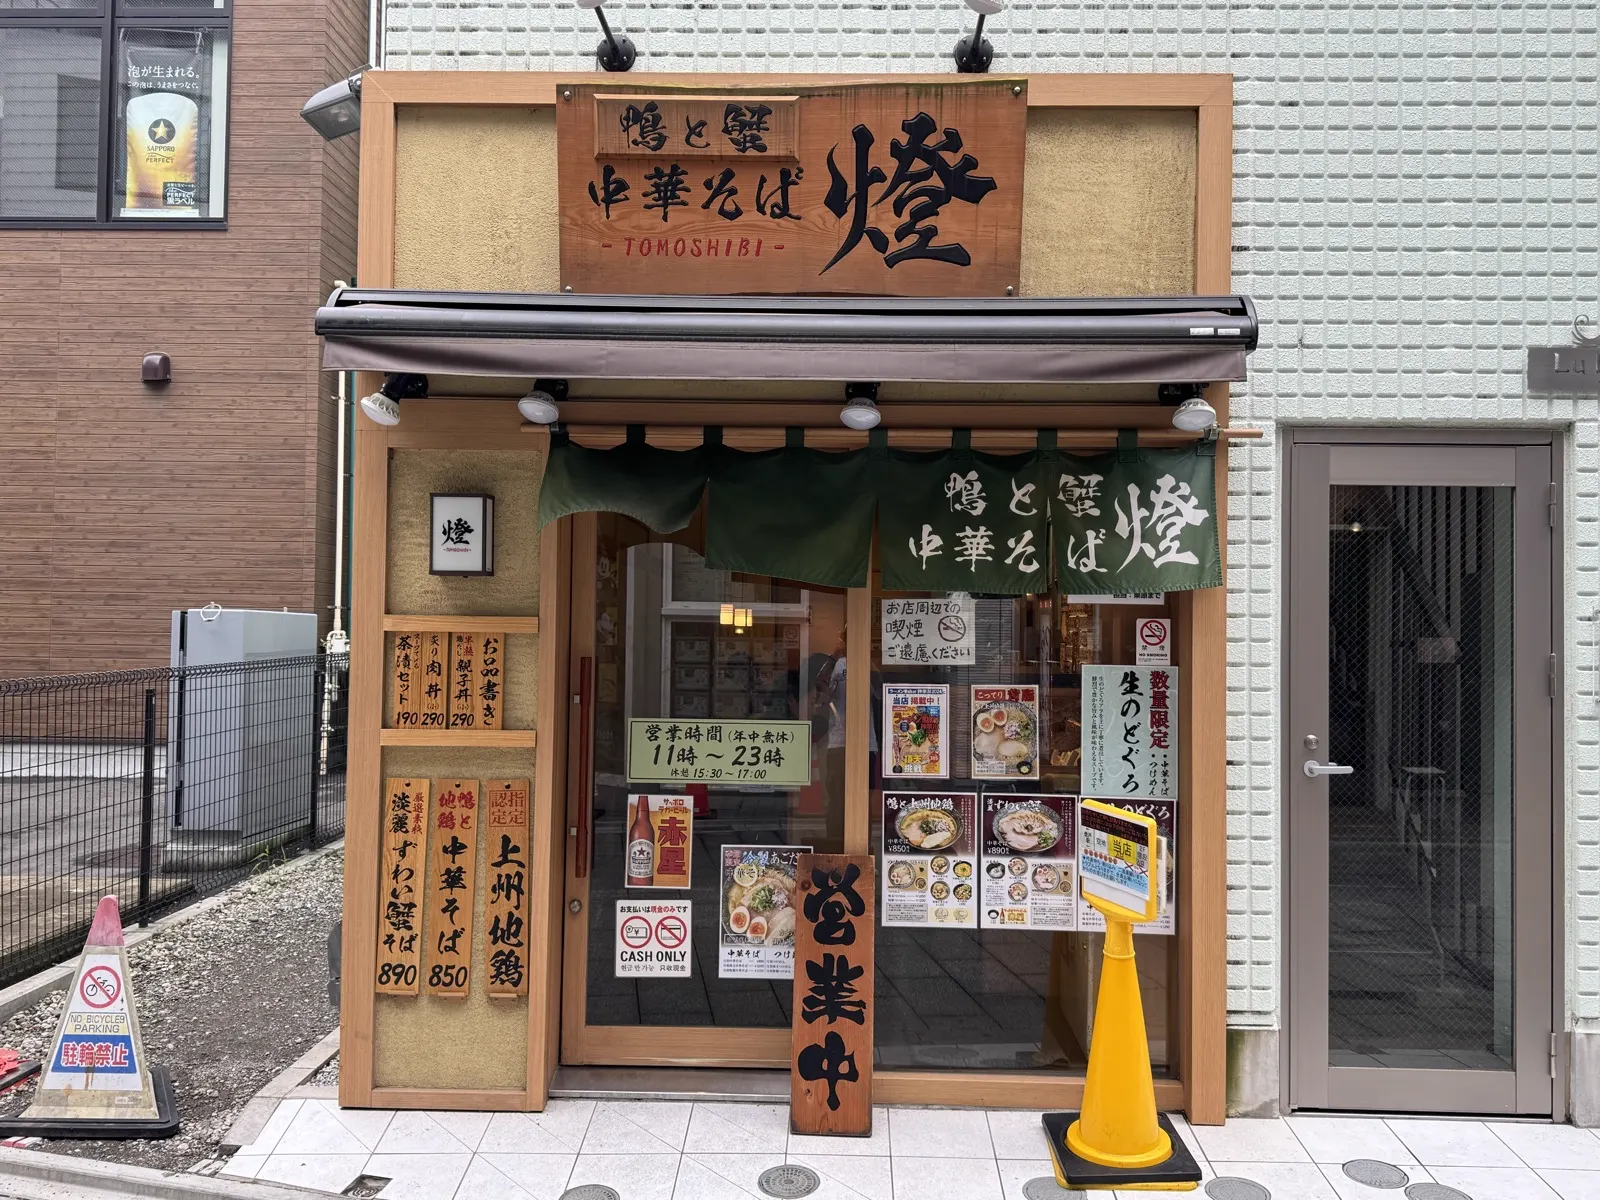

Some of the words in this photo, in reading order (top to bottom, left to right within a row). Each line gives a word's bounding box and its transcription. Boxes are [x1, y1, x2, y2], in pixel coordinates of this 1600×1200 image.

[128, 65, 200, 78] 泡が生まれる。
[619, 101, 773, 153] 鴨と蟹
[588, 163, 803, 222] 中華そば
[818, 111, 998, 276] 燈
[944, 470, 1104, 518] 鴨と蟹
[441, 517, 474, 545] 燈
[1114, 473, 1210, 575] 燈
[908, 524, 1109, 573] 中華そば
[886, 600, 961, 615] お店周辺での
[885, 619, 925, 640] 喫煙
[887, 642, 971, 662] ご遠慮ください
[396, 635, 413, 705] 茶漬セット
[425, 635, 442, 700] 炙り肉丼
[454, 659, 473, 703] 親子丼
[479, 637, 500, 726] お品書き
[893, 696, 909, 705] 当店
[977, 691, 1003, 699] こってり
[396, 711, 419, 725] 190
[421, 712, 445, 726] 290
[451, 713, 475, 727] 290
[1149, 670, 1170, 749] 数量限定
[645, 725, 723, 744] 営業時間
[1118, 670, 1144, 793] 生のどぐろ
[1149, 761, 1158, 796] つけめん
[1161, 761, 1170, 796] 中華そば
[437, 790, 457, 830] 地鶏
[458, 791, 476, 830] 鴨と
[490, 792, 508, 826] 認定
[508, 792, 525, 826] 指定
[659, 806, 688, 814] ラガービール
[663, 798, 684, 806] サッポロ
[886, 797, 954, 811] 鴨と上州地鶏
[657, 816, 687, 875] 赤星
[1112, 838, 1131, 857] 当店
[438, 836, 468, 956] 中華そば
[620, 905, 689, 914] お支払いは現金のみです
[489, 834, 526, 988] 上州地鶏
[620, 951, 653, 962] CASH
[656, 951, 687, 962] ONLY
[727, 949, 761, 958] 中華そば
[774, 949, 796, 959] つけ
[378, 963, 417, 986] 890
[429, 964, 468, 988] 850
[798, 863, 867, 1111] 営業中
[70, 1015, 82, 1023] NO
[86, 1015, 125, 1024] BICYCLES
[74, 1024, 120, 1034] PARKING
[61, 1042, 129, 1067] 駐輪禁止
